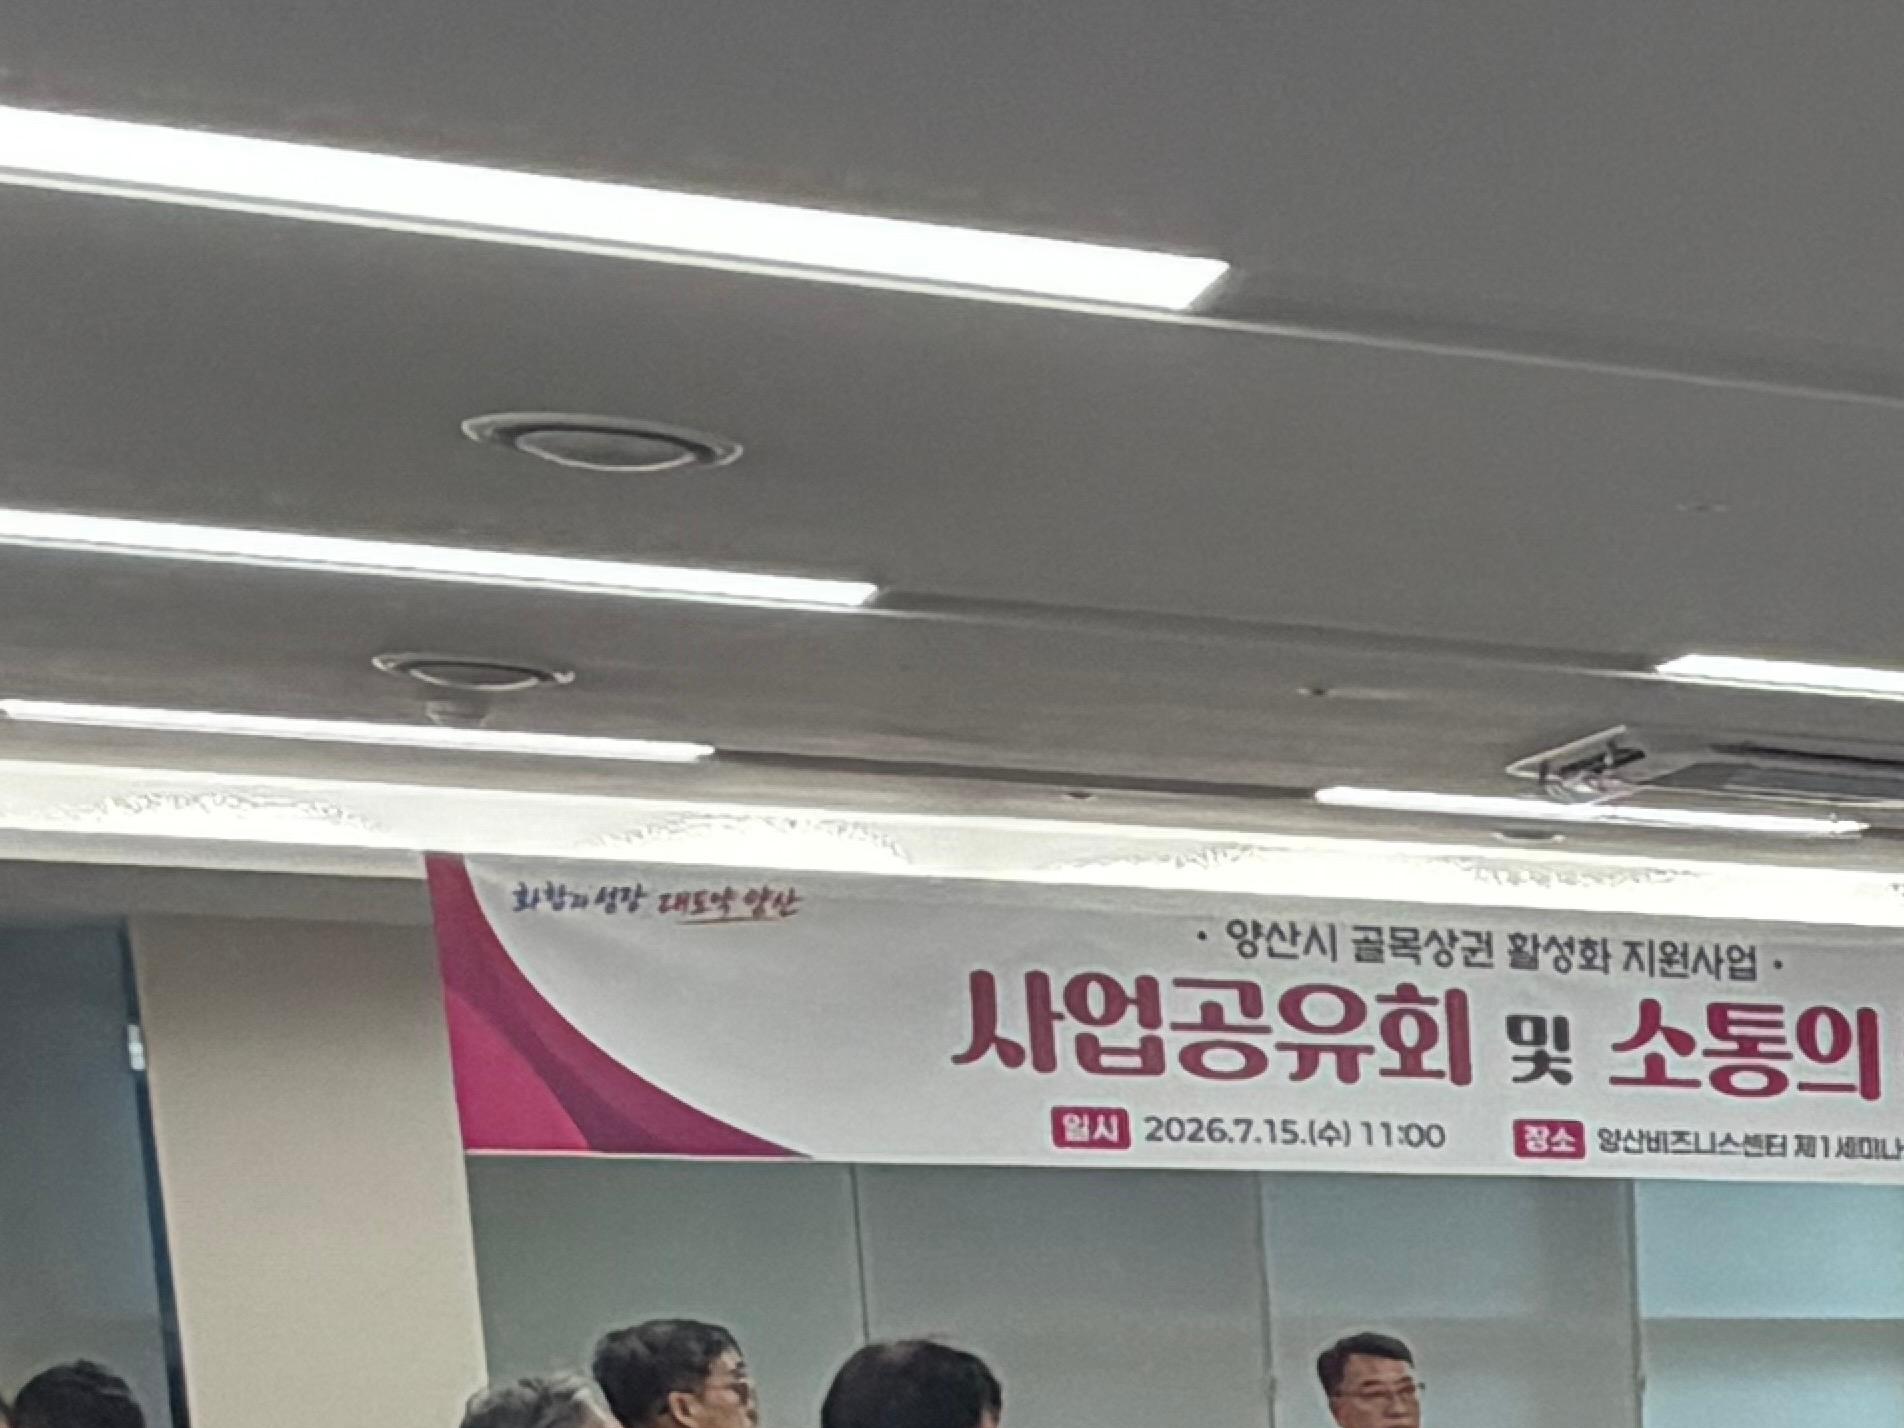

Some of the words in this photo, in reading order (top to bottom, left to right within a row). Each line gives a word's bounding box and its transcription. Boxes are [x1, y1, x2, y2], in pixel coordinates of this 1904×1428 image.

[1225, 918, 1338, 963] 양산시
[1352, 924, 1494, 969] 골목상권
[1507, 931, 1613, 975] 활성화
[1622, 938, 1758, 982] 지원사업
[951, 968, 1474, 1086] 사업공유회
[1505, 1014, 1573, 1085] 및
[1608, 998, 1882, 1102] 소통의
[1062, 1112, 1120, 1144] 일시
[1144, 1115, 1352, 1148] 2026.7.15.(수)
[1364, 1120, 1446, 1149] 11:00
[1523, 1124, 1578, 1154] 장소
[1597, 1126, 1788, 1158] 양산비즈니스센터
